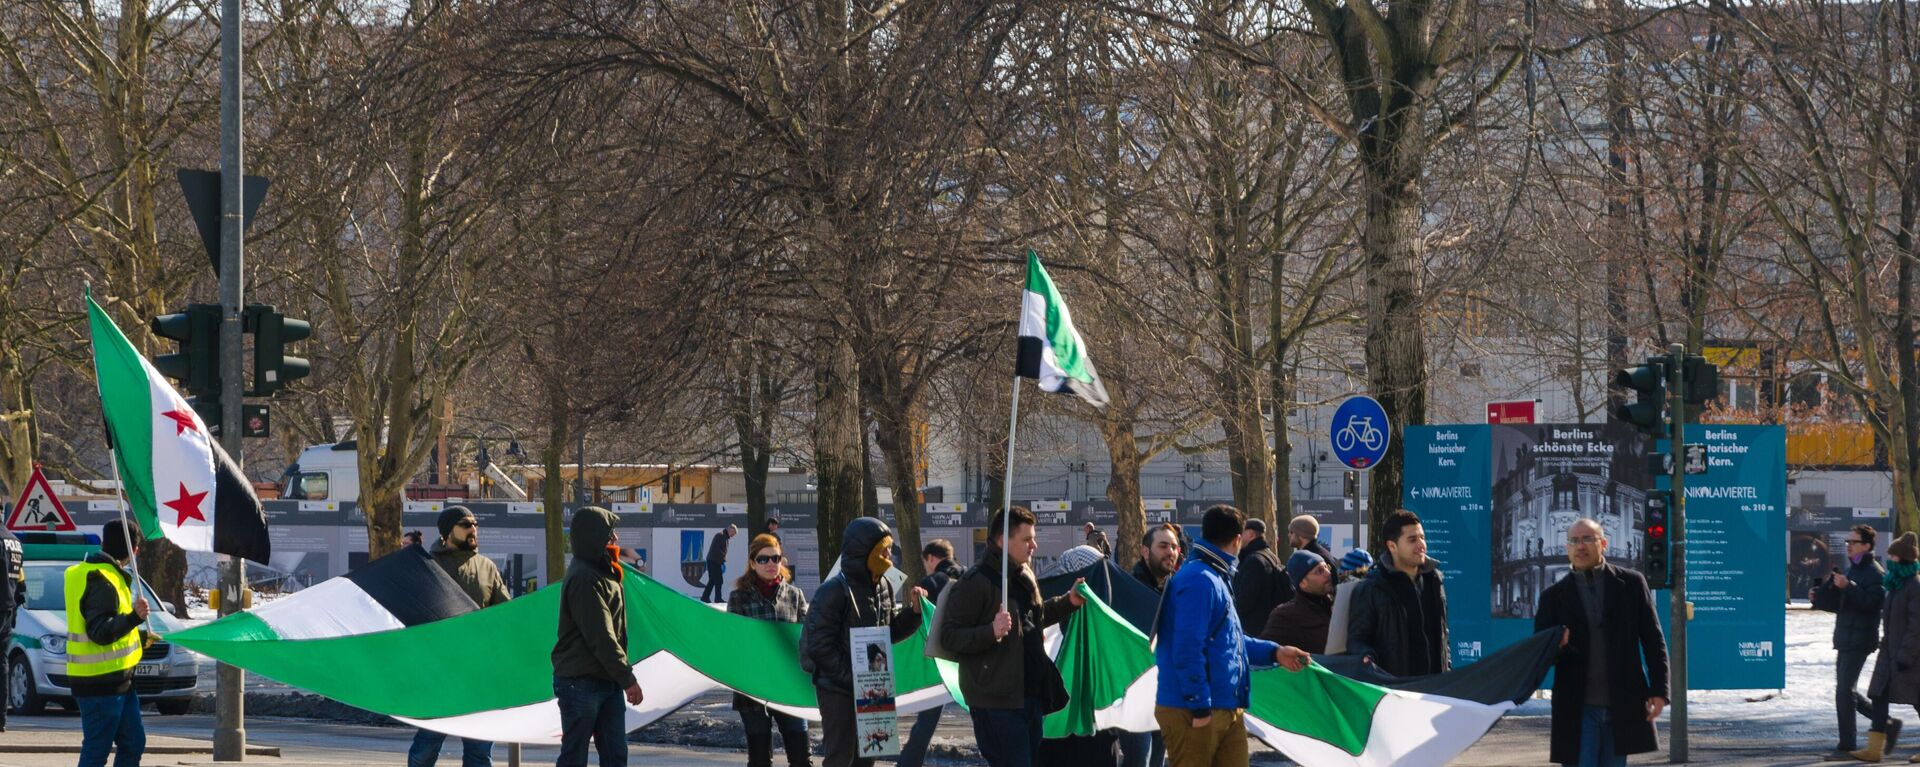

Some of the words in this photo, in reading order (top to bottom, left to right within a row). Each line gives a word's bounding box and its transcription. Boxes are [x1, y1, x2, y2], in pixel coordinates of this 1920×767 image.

[1436, 430, 1459, 440] Berlins
[1553, 429, 1594, 439] Berlins
[1705, 430, 1737, 440] Berlins
[1428, 443, 1466, 453] historischer
[1533, 442, 1583, 453] schönste
[1587, 442, 1614, 452] Ecke
[1438, 457, 1456, 466] Kern.
[1708, 456, 1734, 466] Kern.
[1421, 486, 1472, 498] NIKOLAIVIERTEL
[1683, 486, 1757, 498] NIKOLAIVIERTEL
[1753, 503, 1766, 511] 210
